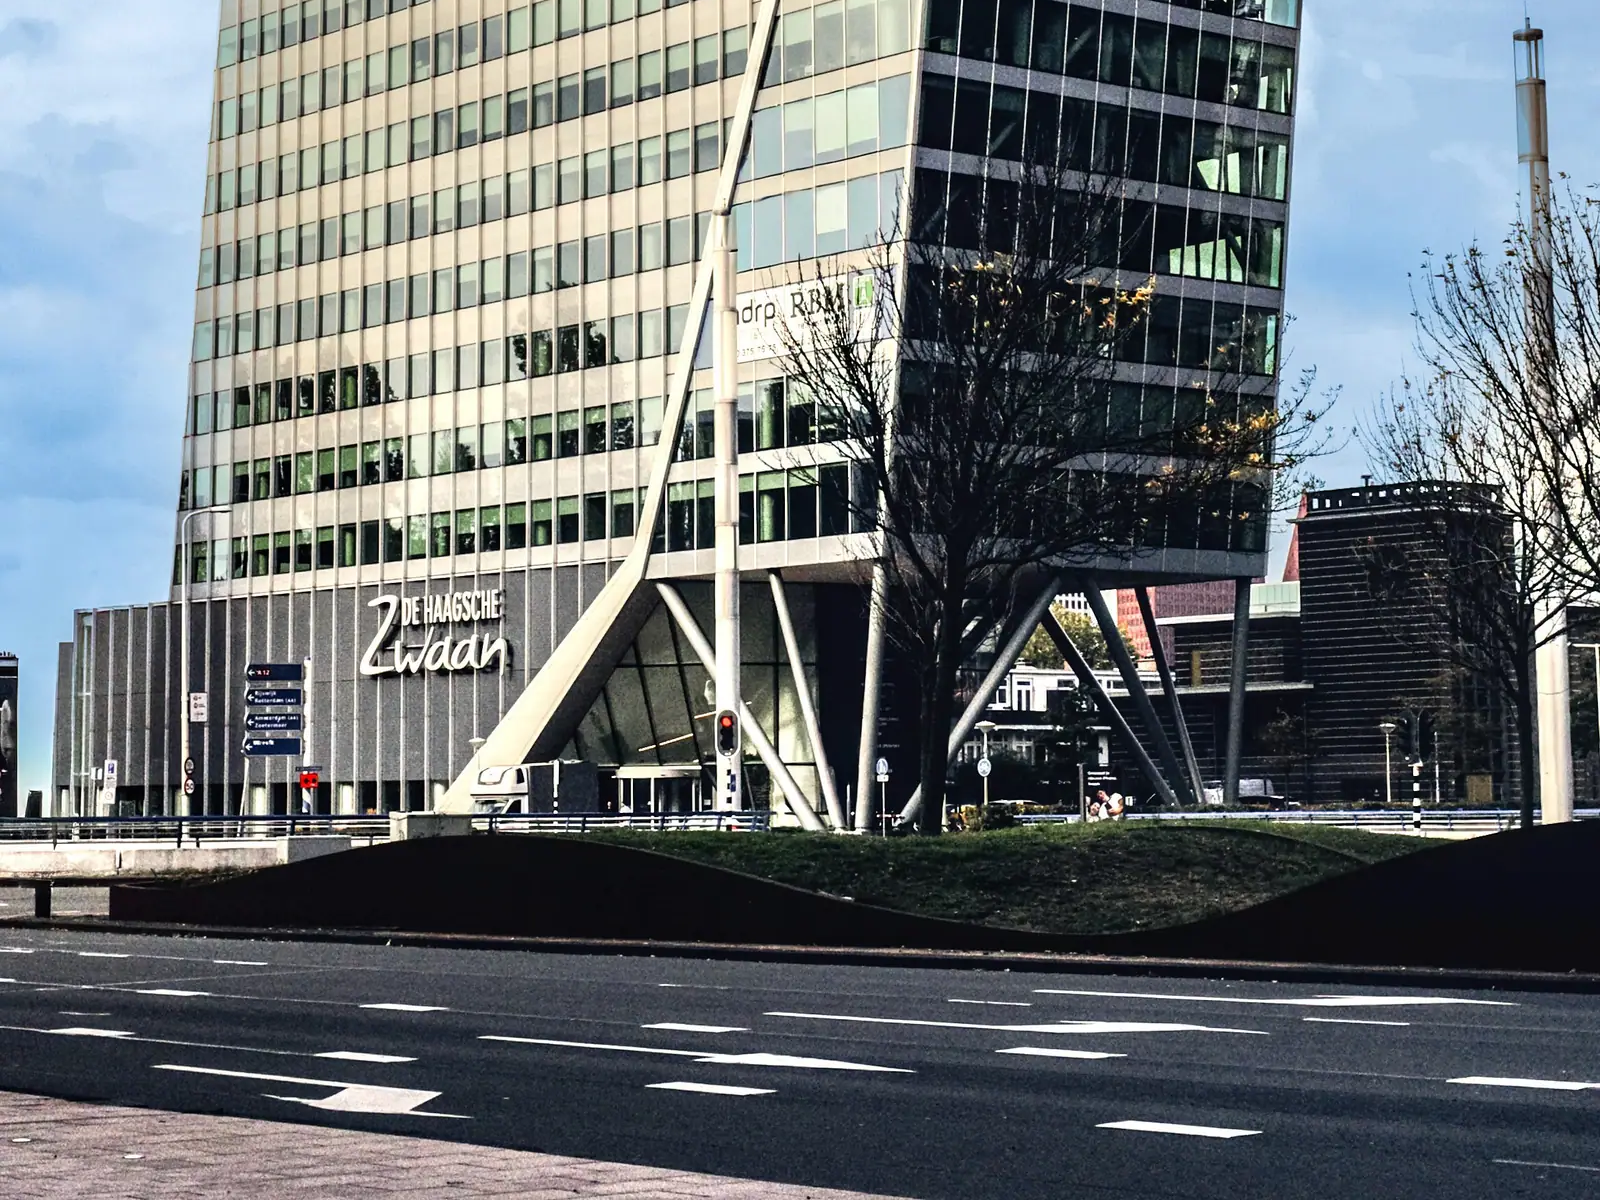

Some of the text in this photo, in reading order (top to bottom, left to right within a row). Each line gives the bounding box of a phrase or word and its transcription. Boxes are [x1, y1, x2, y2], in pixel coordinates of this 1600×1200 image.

[359, 594, 508, 677] Zwaan
[402, 589, 500, 627] DE HAAGSCHE
